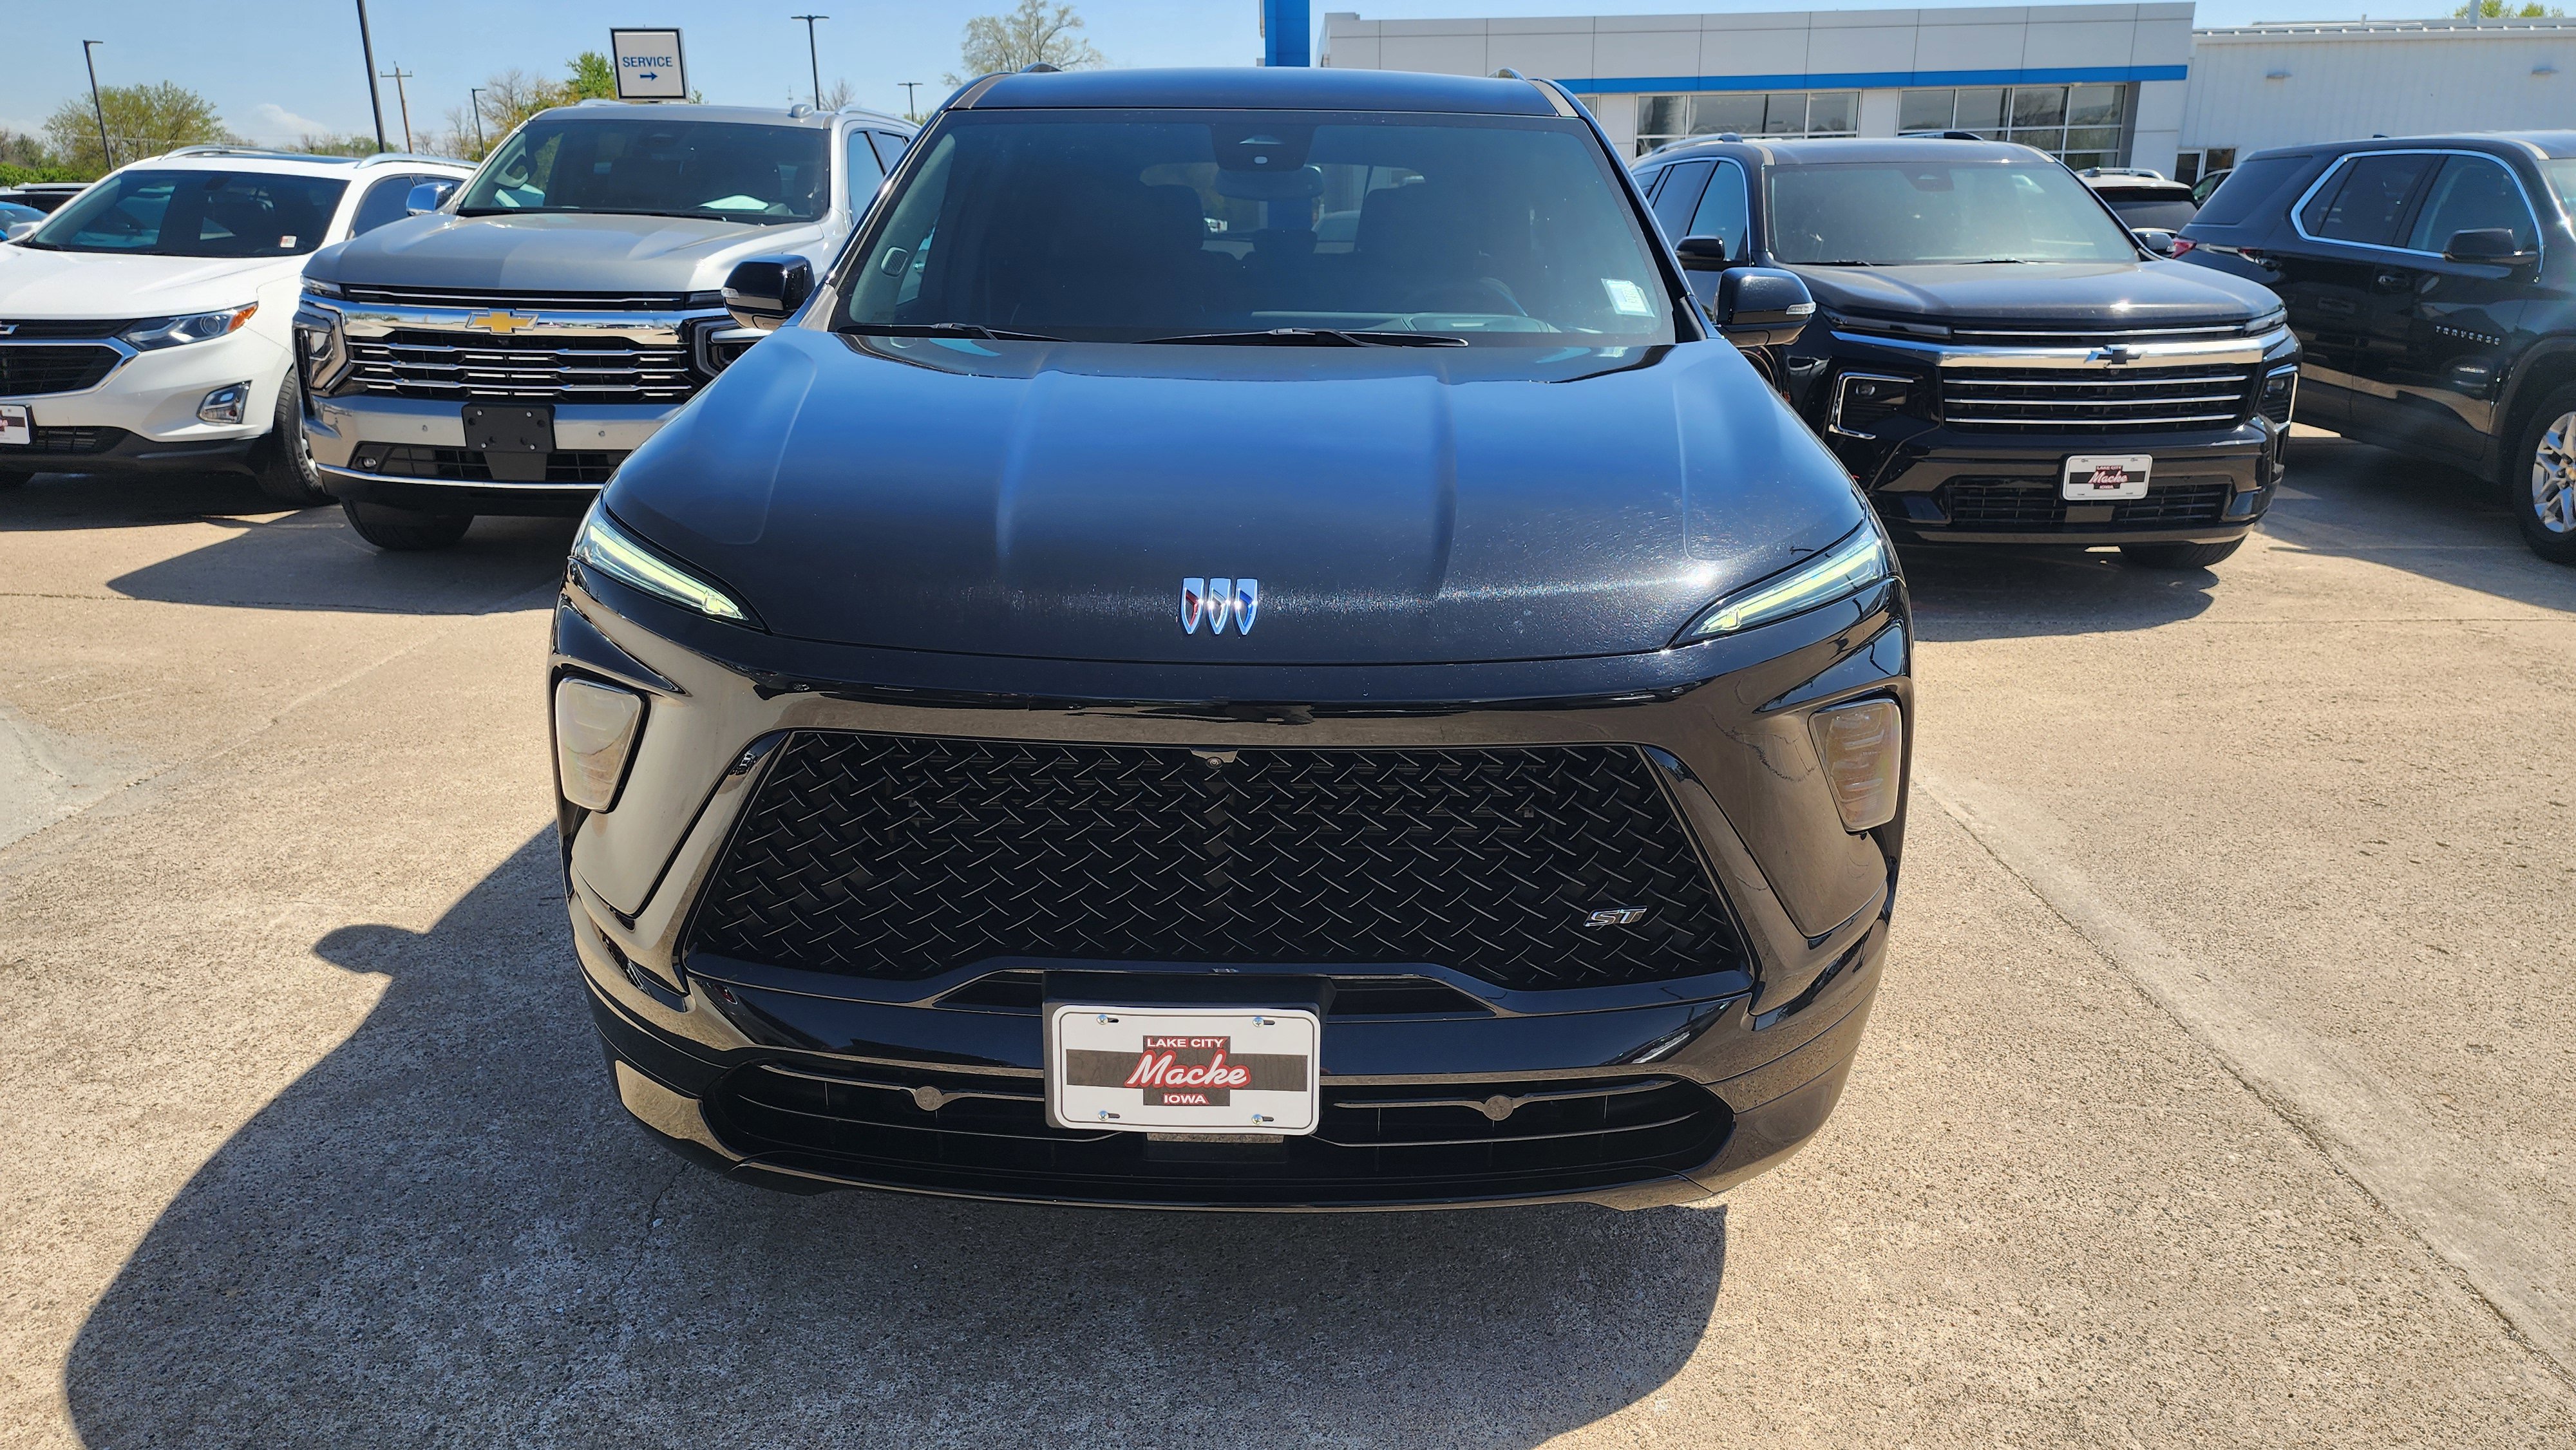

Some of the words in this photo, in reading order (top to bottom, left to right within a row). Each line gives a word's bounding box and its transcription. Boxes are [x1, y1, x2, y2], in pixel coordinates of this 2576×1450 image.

[622, 56, 673, 68] SERVICE
[2436, 325, 2500, 346] TRAVERSE
[2087, 470, 2128, 484] Macke
[1585, 907, 1647, 927] ST
[1147, 1038, 1187, 1048] LAKE
[1191, 1038, 1224, 1048] CITY
[1126, 1051, 1248, 1086] Macke
[1164, 1094, 1208, 1104] IOWA
